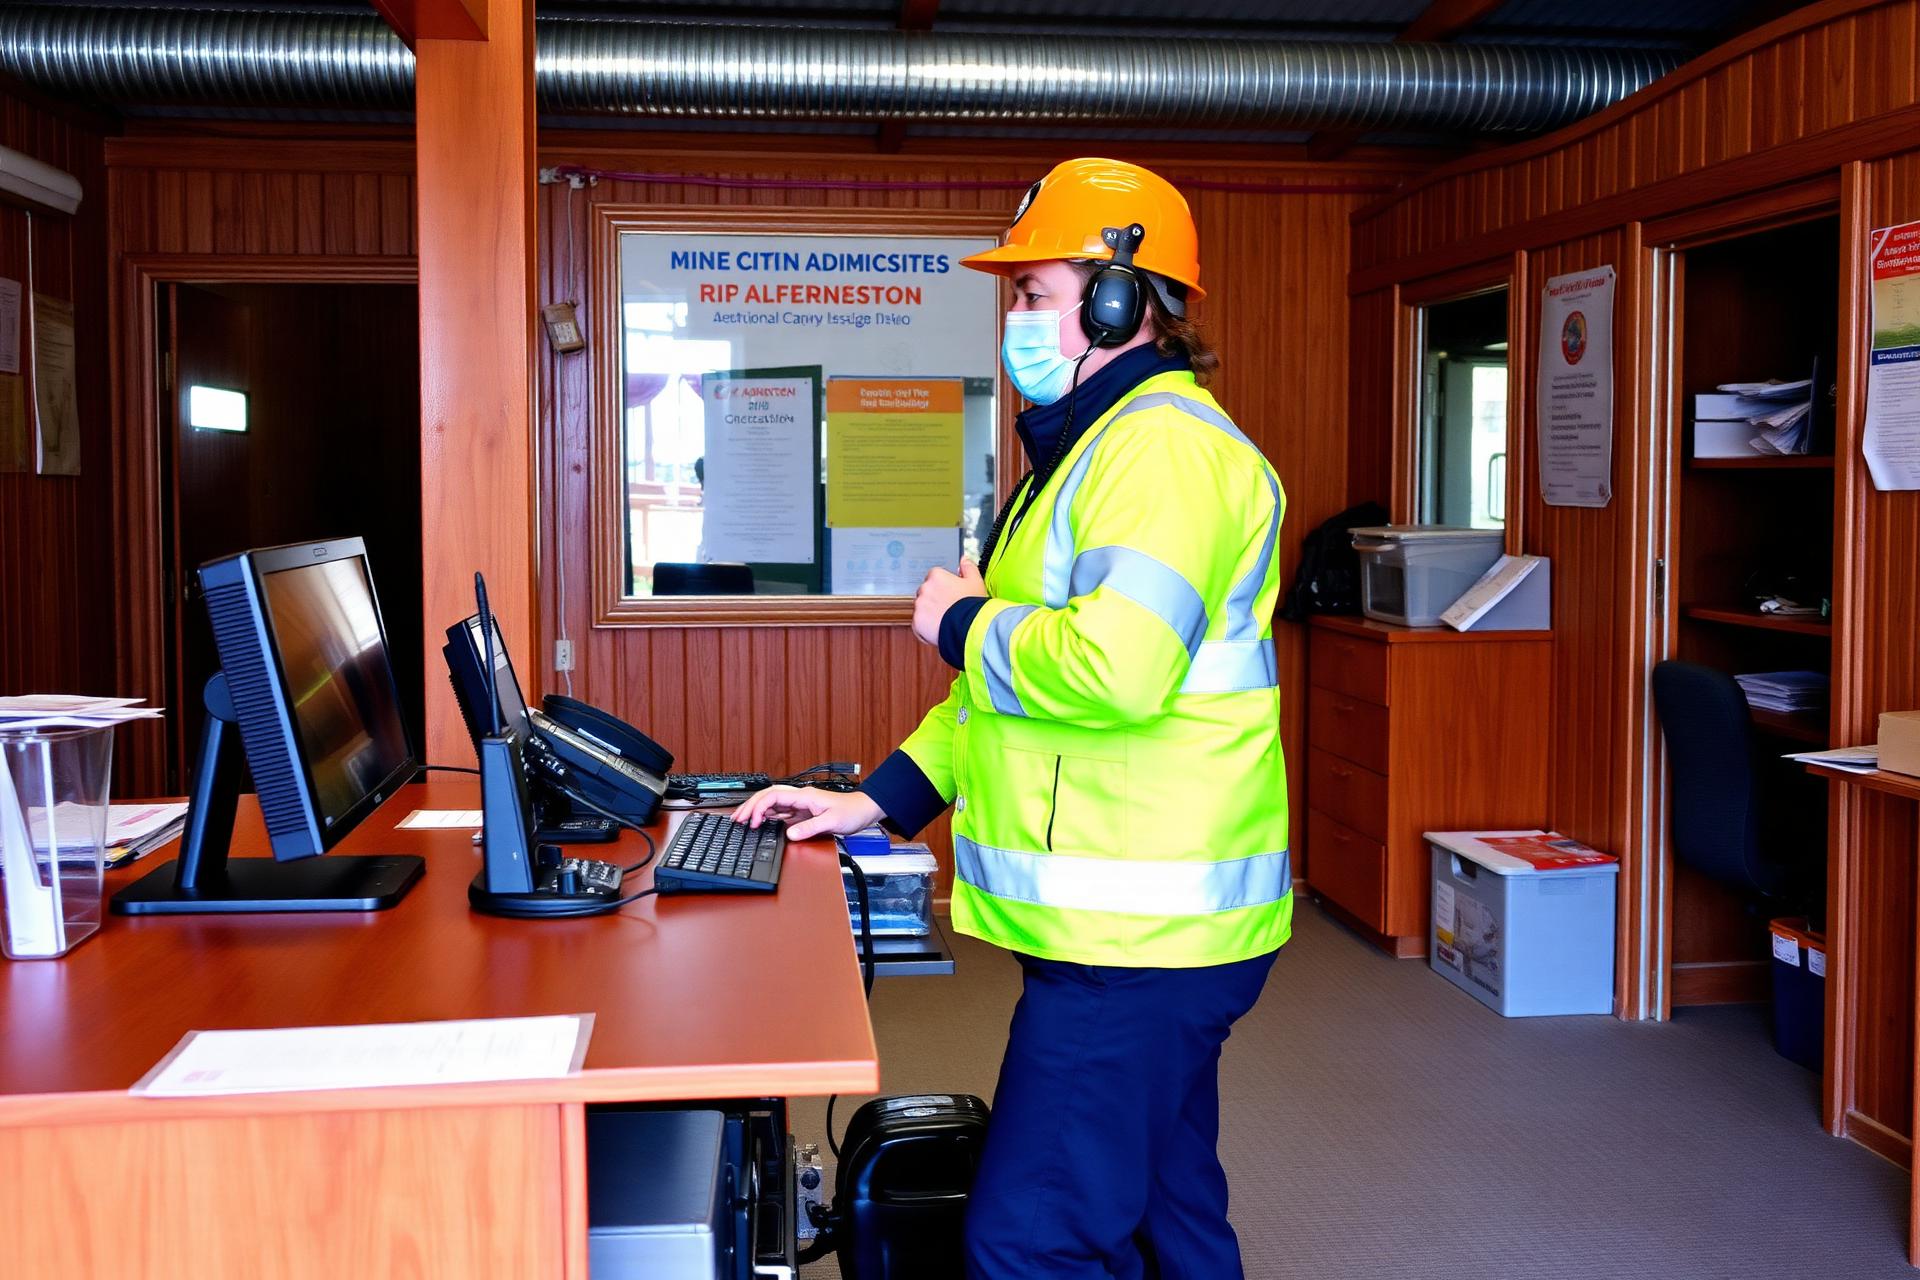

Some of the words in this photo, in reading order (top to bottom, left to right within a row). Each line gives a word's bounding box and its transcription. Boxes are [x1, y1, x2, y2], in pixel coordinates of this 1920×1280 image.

[671, 251, 730, 270] MINE
[736, 251, 799, 271] CITIN
[805, 252, 950, 273] ADIMICSITES
[700, 283, 739, 303] RIP
[744, 284, 922, 305] ALFERNESTON
